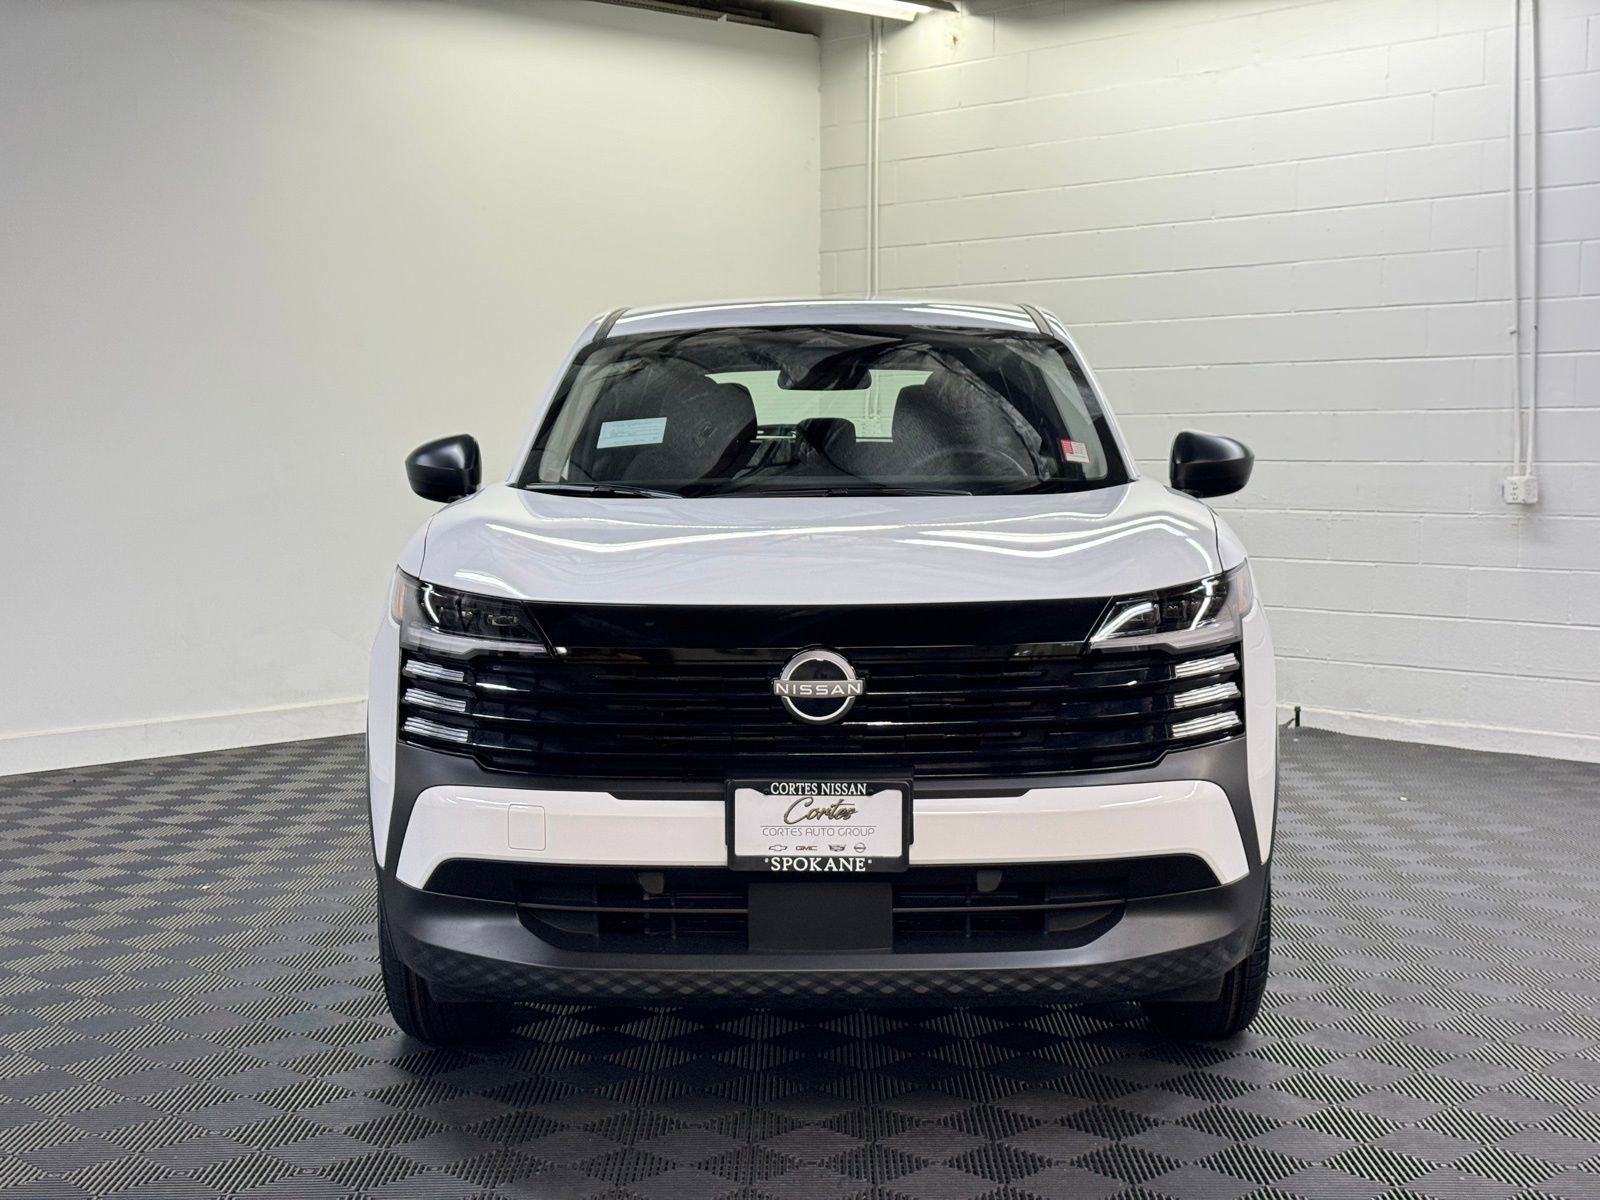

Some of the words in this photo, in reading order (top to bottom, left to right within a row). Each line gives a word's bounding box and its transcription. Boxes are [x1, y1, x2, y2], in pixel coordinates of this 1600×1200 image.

[775, 682, 861, 695] NISSAN
[770, 782, 818, 795] CORTES
[821, 783, 867, 795] NISSAN
[783, 796, 859, 825] Cortes
[762, 827, 803, 837] CORTES
[805, 827, 835, 837] AUTO
[837, 827, 875, 837] GROUP
[770, 857, 866, 872] SPOKANE
